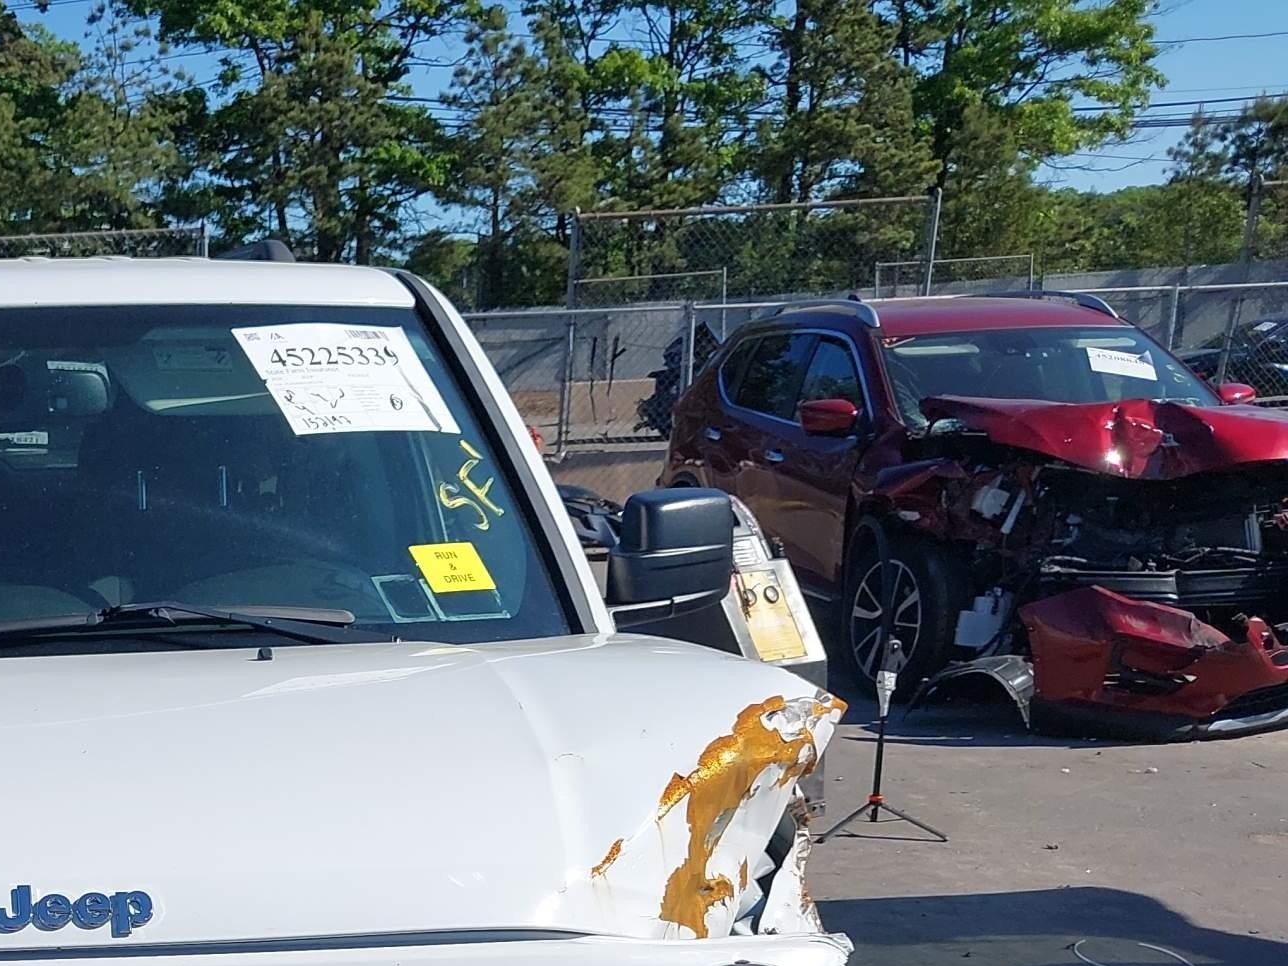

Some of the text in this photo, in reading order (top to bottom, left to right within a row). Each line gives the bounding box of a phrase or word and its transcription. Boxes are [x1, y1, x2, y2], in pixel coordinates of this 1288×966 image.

[270, 346, 399, 367] 45225339
[434, 551, 458, 560] RUN
[449, 563, 457, 571] &
[443, 573, 476, 584] DRIVE
